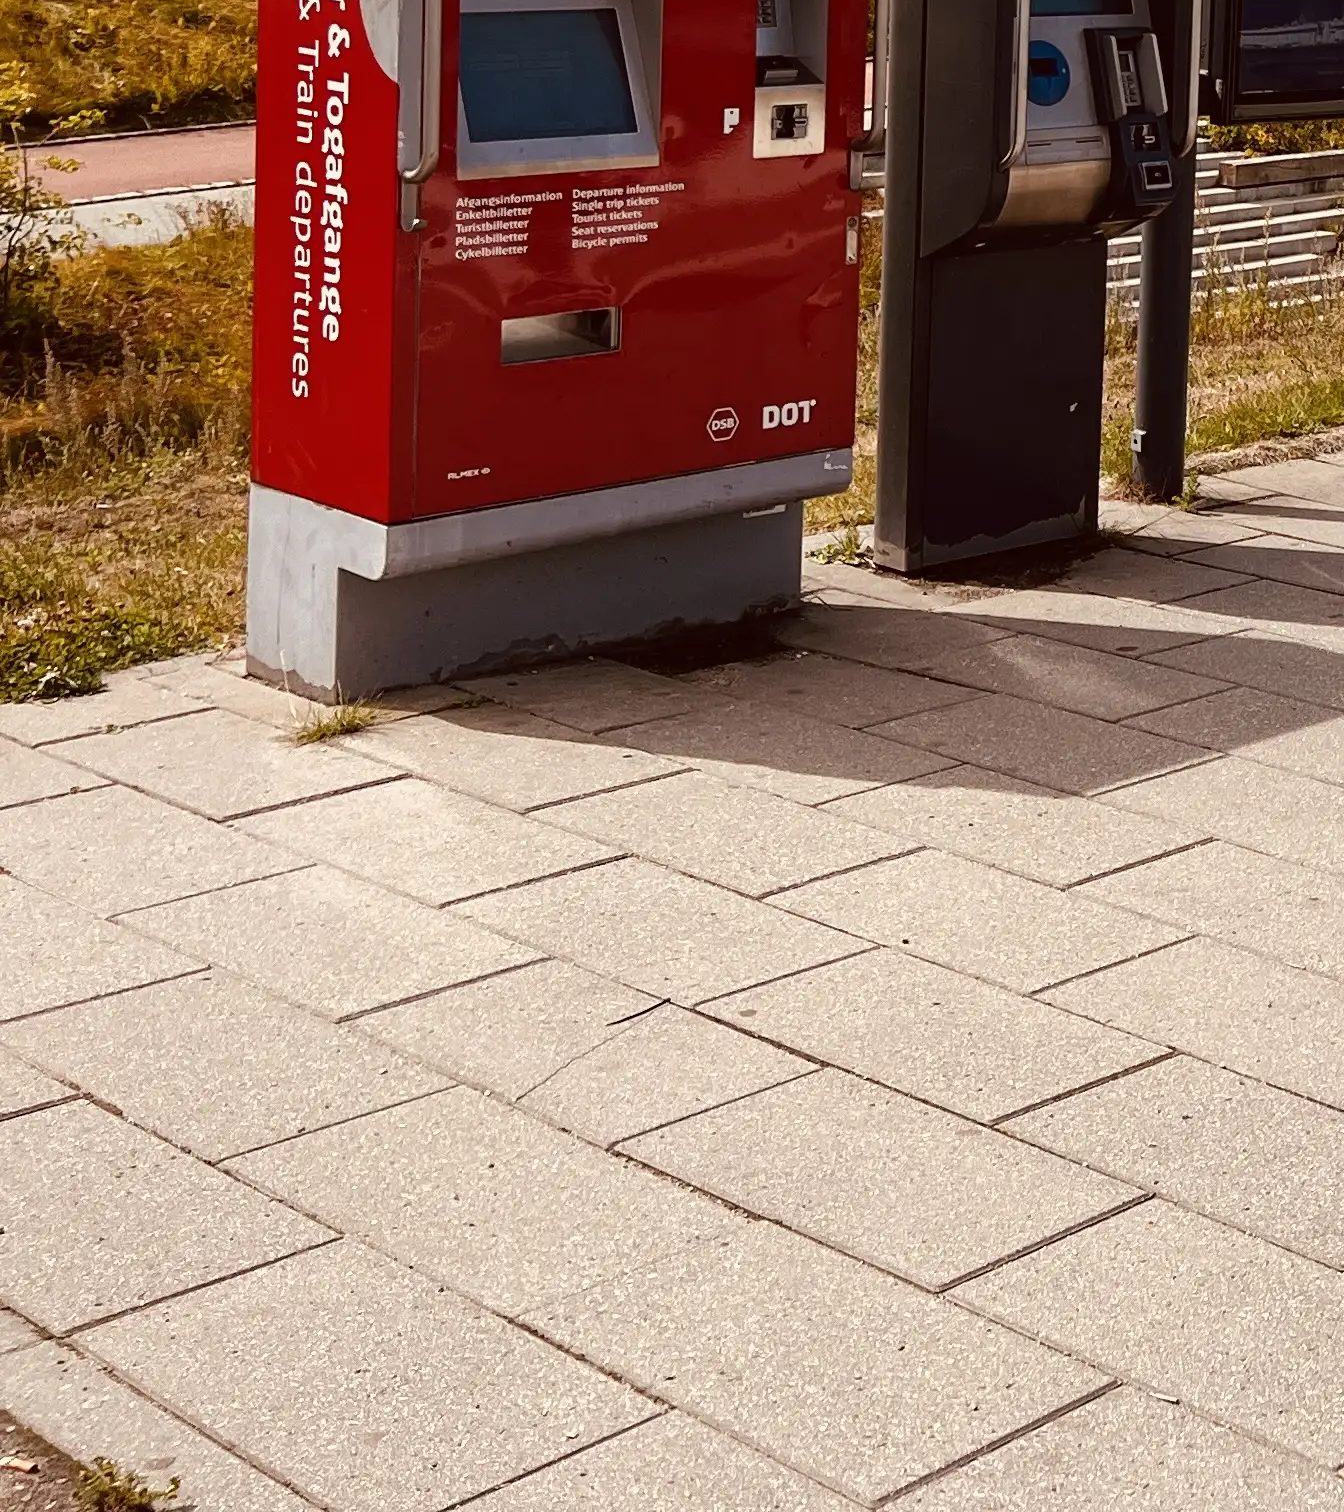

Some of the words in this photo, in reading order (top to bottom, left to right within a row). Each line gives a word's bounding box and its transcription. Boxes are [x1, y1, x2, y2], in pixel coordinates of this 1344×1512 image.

[327, 23, 350, 58] &
[296, 40, 319, 144] Train
[572, 187, 624, 200] Departure
[626, 182, 684, 195] information
[319, 72, 349, 341] Togafgange
[455, 191, 563, 208] Afgangsinformation
[572, 200, 603, 212] Single
[606, 199, 624, 211] trip
[626, 196, 660, 208] tickets
[456, 206, 533, 220] Enkeltbilletter
[572, 212, 606, 224] Tourist
[609, 209, 643, 221] tickets
[455, 220, 529, 233] Turistbilletter
[572, 225, 594, 236] Seat
[596, 220, 659, 234] reservations
[455, 232, 529, 246] Pladsbilletter
[572, 237, 607, 250] Bicycle
[609, 233, 648, 247] permits
[455, 245, 528, 261] Cykelbilletter
[290, 161, 318, 398] departures
[762, 399, 816, 429] DOT
[711, 418, 735, 431] DSB
